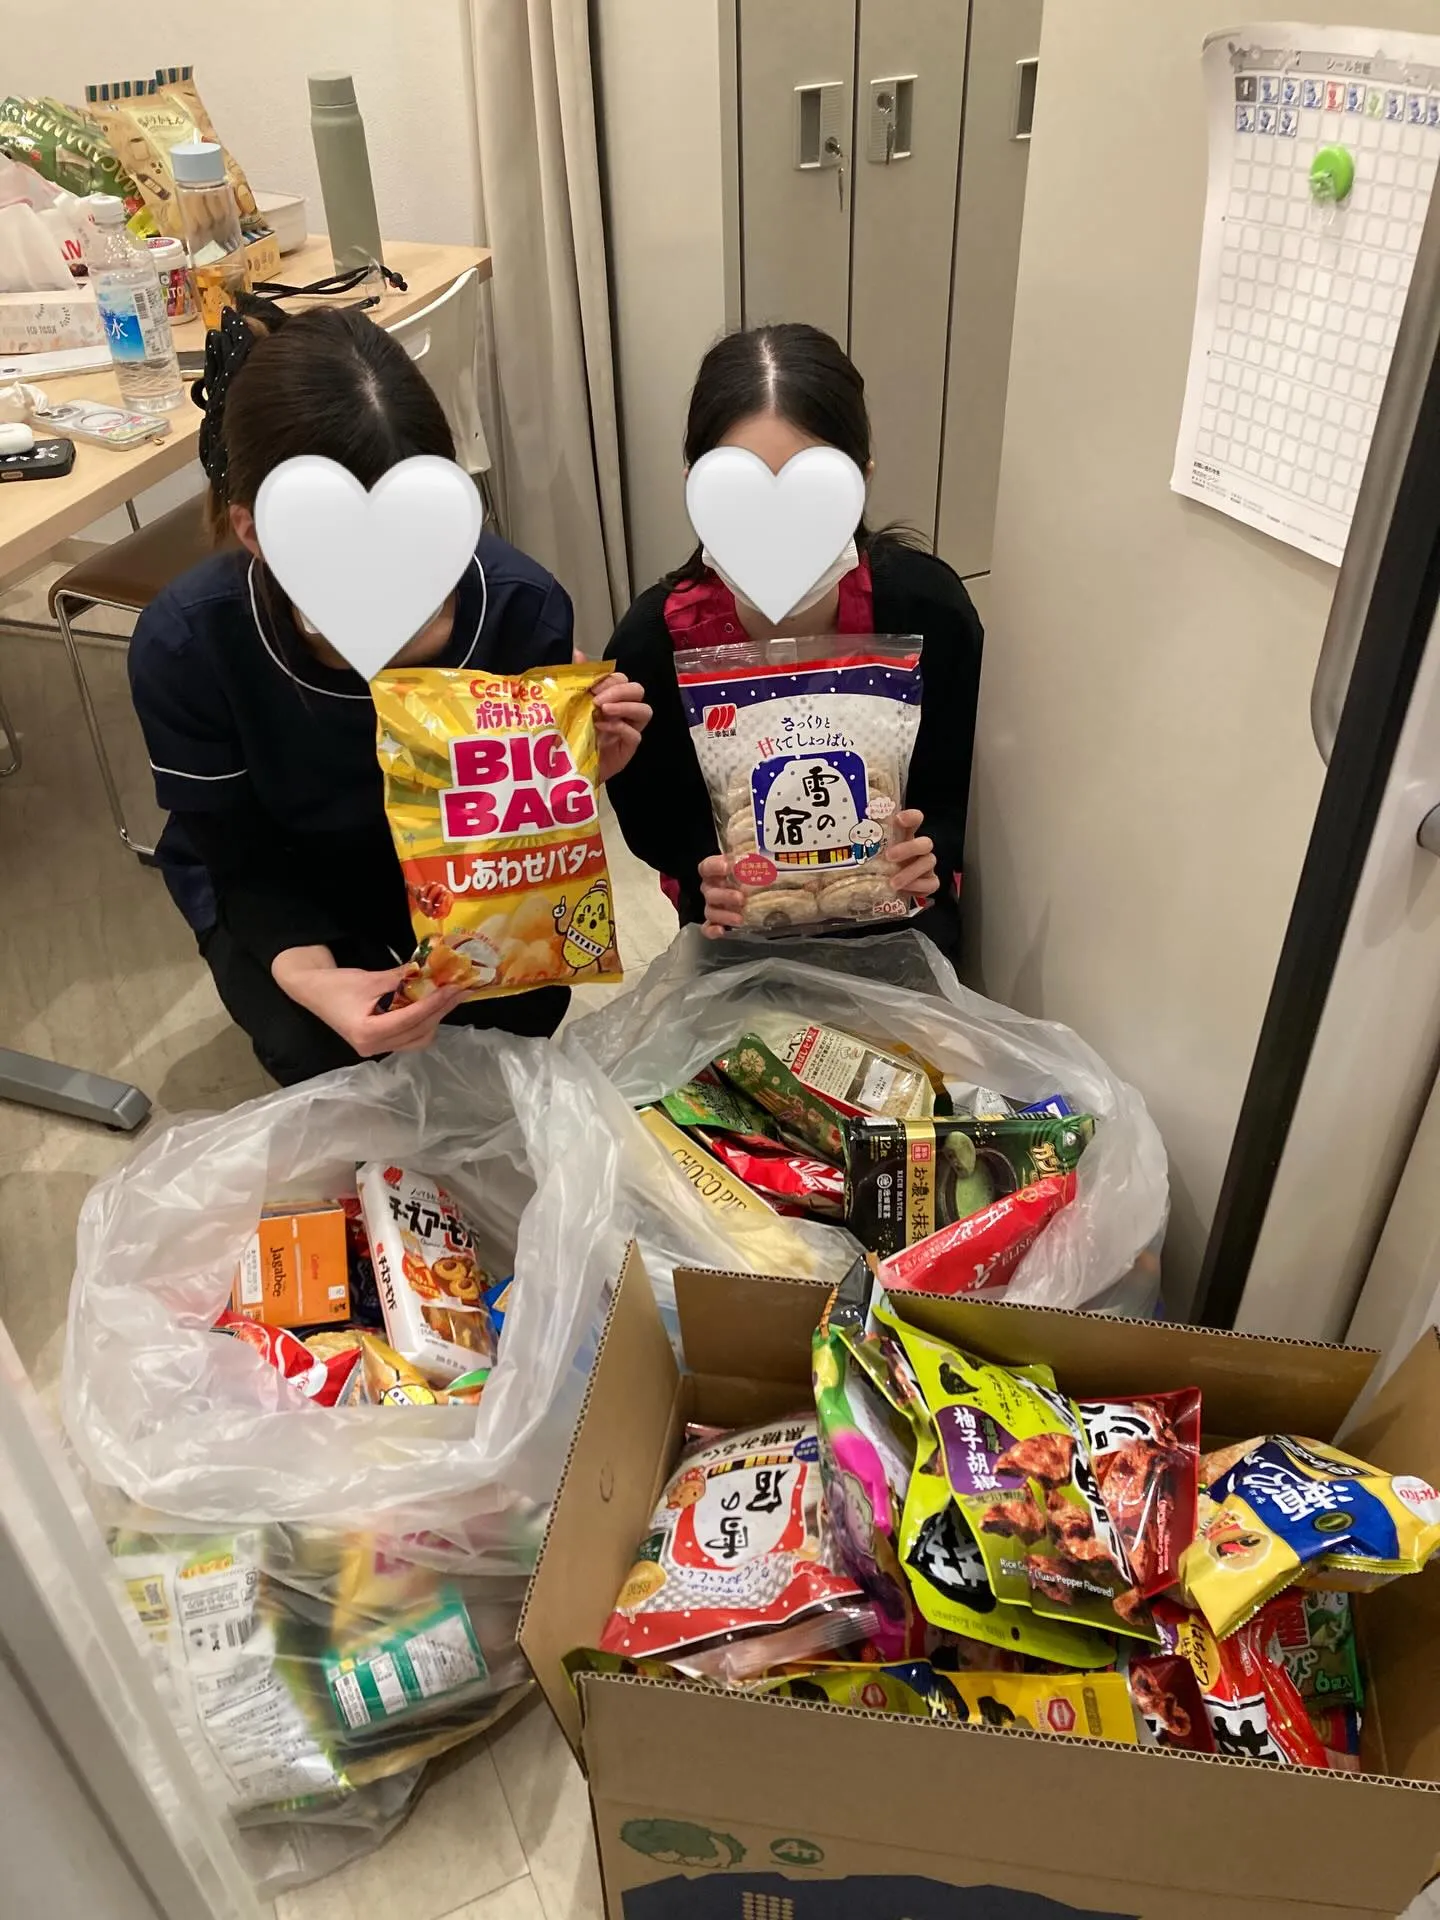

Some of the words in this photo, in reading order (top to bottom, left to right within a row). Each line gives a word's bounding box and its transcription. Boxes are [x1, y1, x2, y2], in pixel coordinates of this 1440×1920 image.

[781, 715, 831, 732] さっくりと
[454, 733, 573, 787] BIG
[757, 732, 854, 758] 甘くてしょっぱい
[444, 779, 595, 838] BAG
[568, 929, 603, 955] POTATO
[269, 1246, 282, 1298] Jagabee
[953, 1406, 1003, 1491] 柚子胡椒
[1000, 1558, 1017, 1569] Rice
